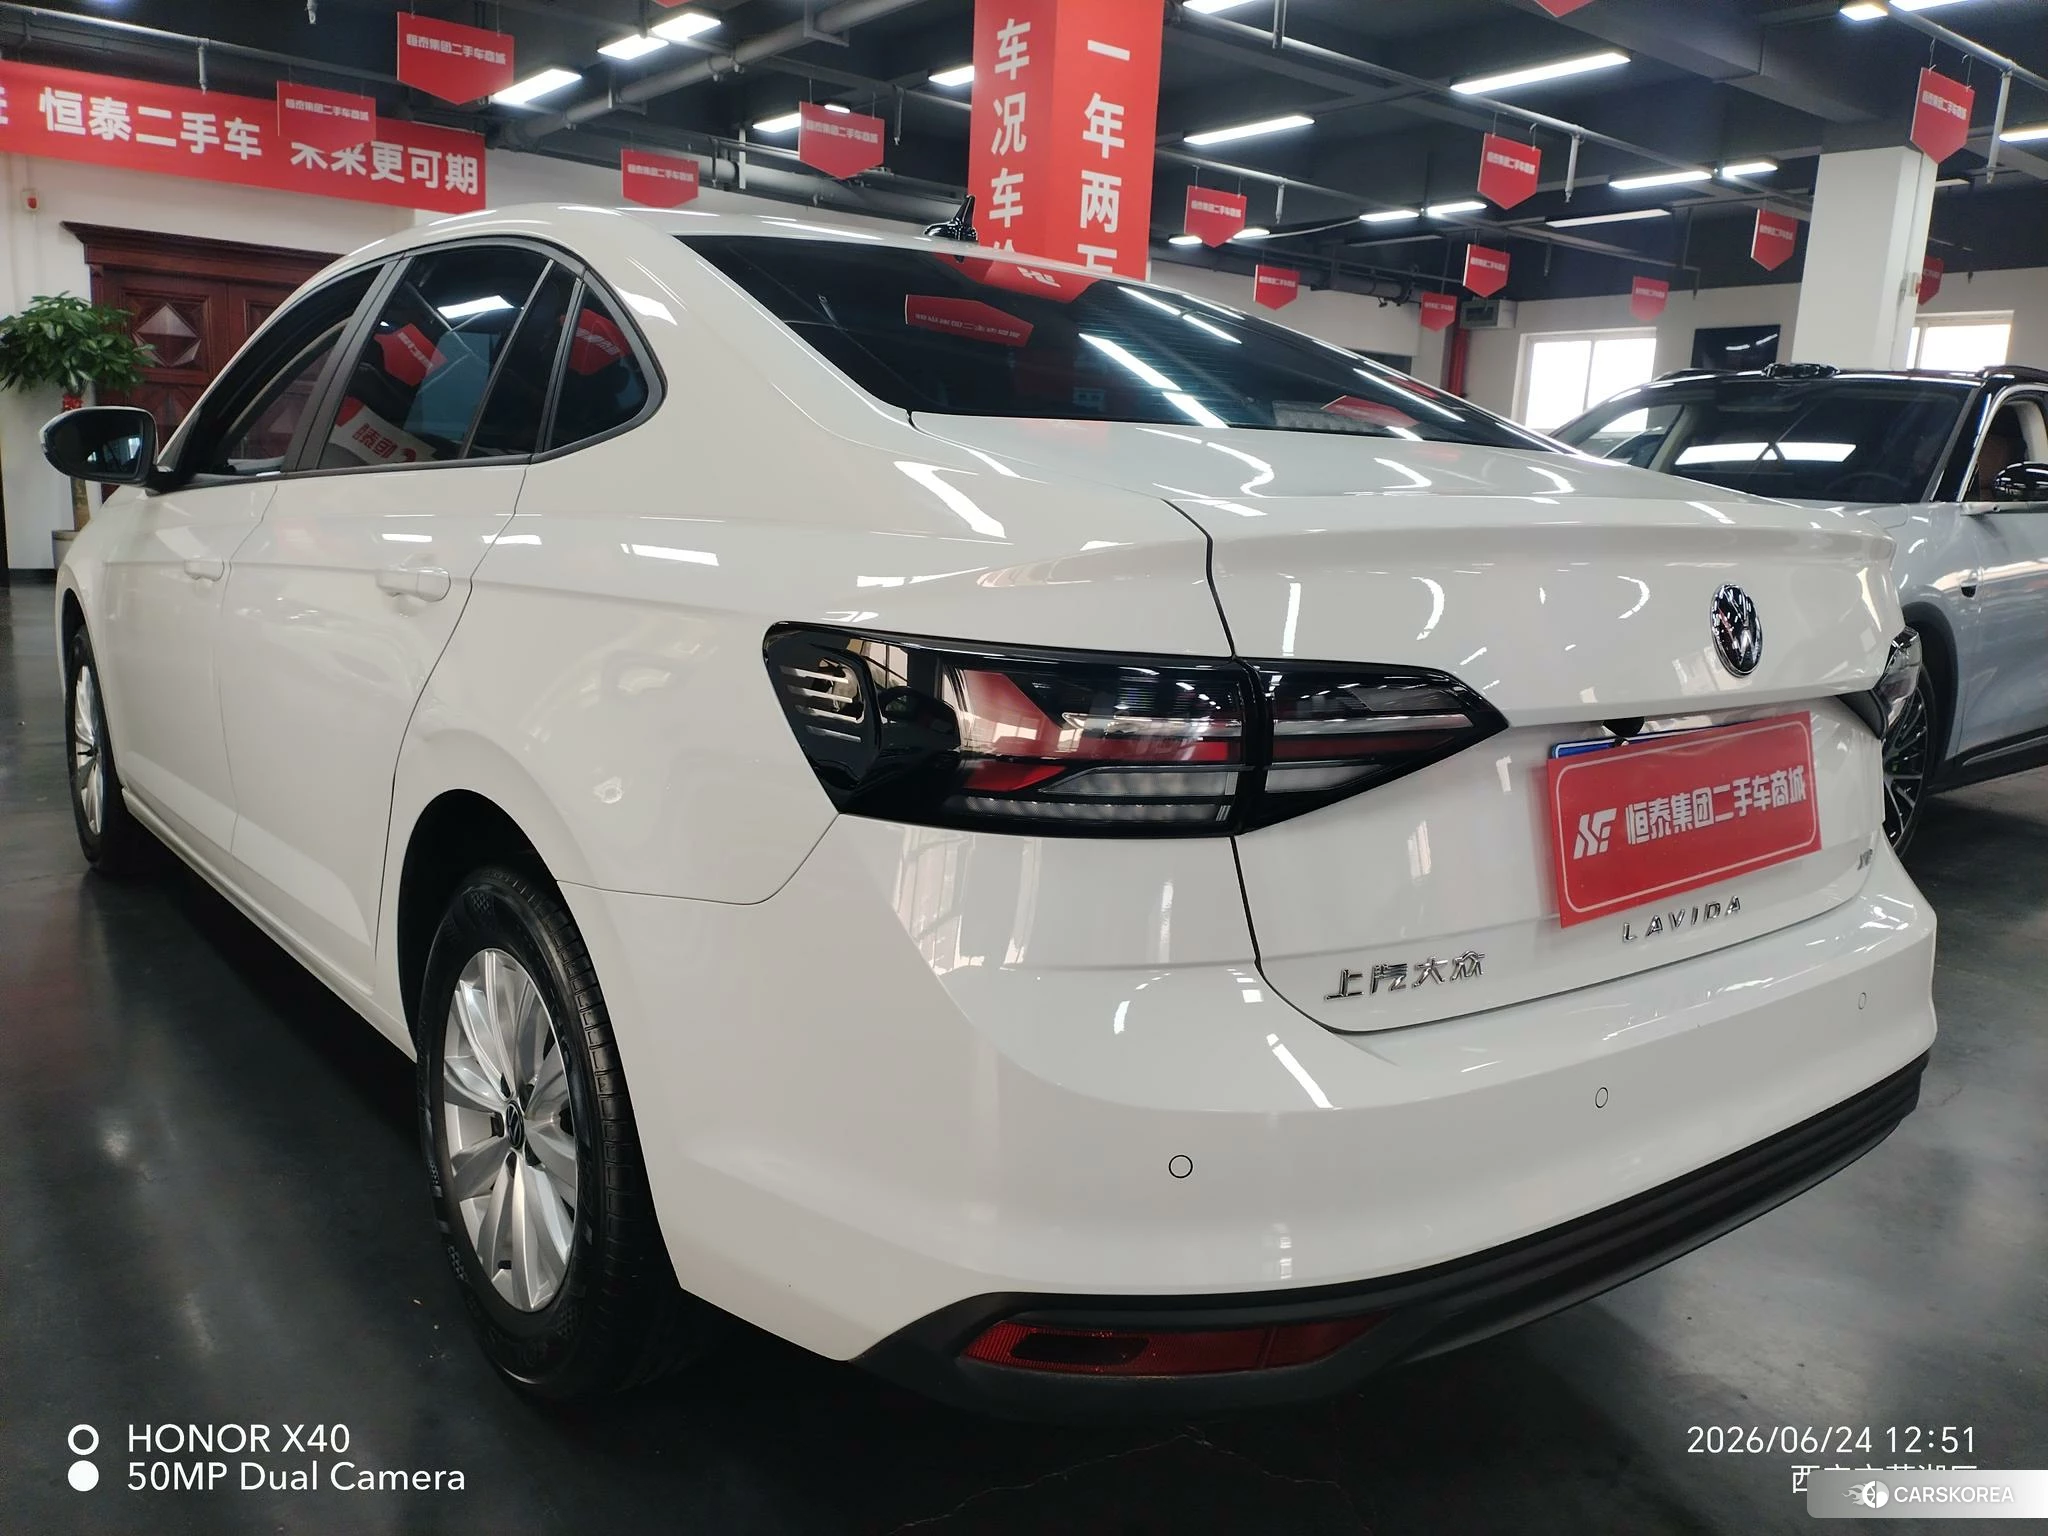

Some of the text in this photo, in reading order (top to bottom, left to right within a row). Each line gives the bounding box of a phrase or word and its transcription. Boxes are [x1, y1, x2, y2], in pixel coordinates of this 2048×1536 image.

[39, 86, 263, 161] 恒泰二手车
[989, 18, 1031, 253] 车况车
[1624, 765, 1807, 845] 恒泰集团二手车商城
[1622, 895, 1741, 943] LAVIDA
[1324, 950, 1486, 1001] 上汽大众
